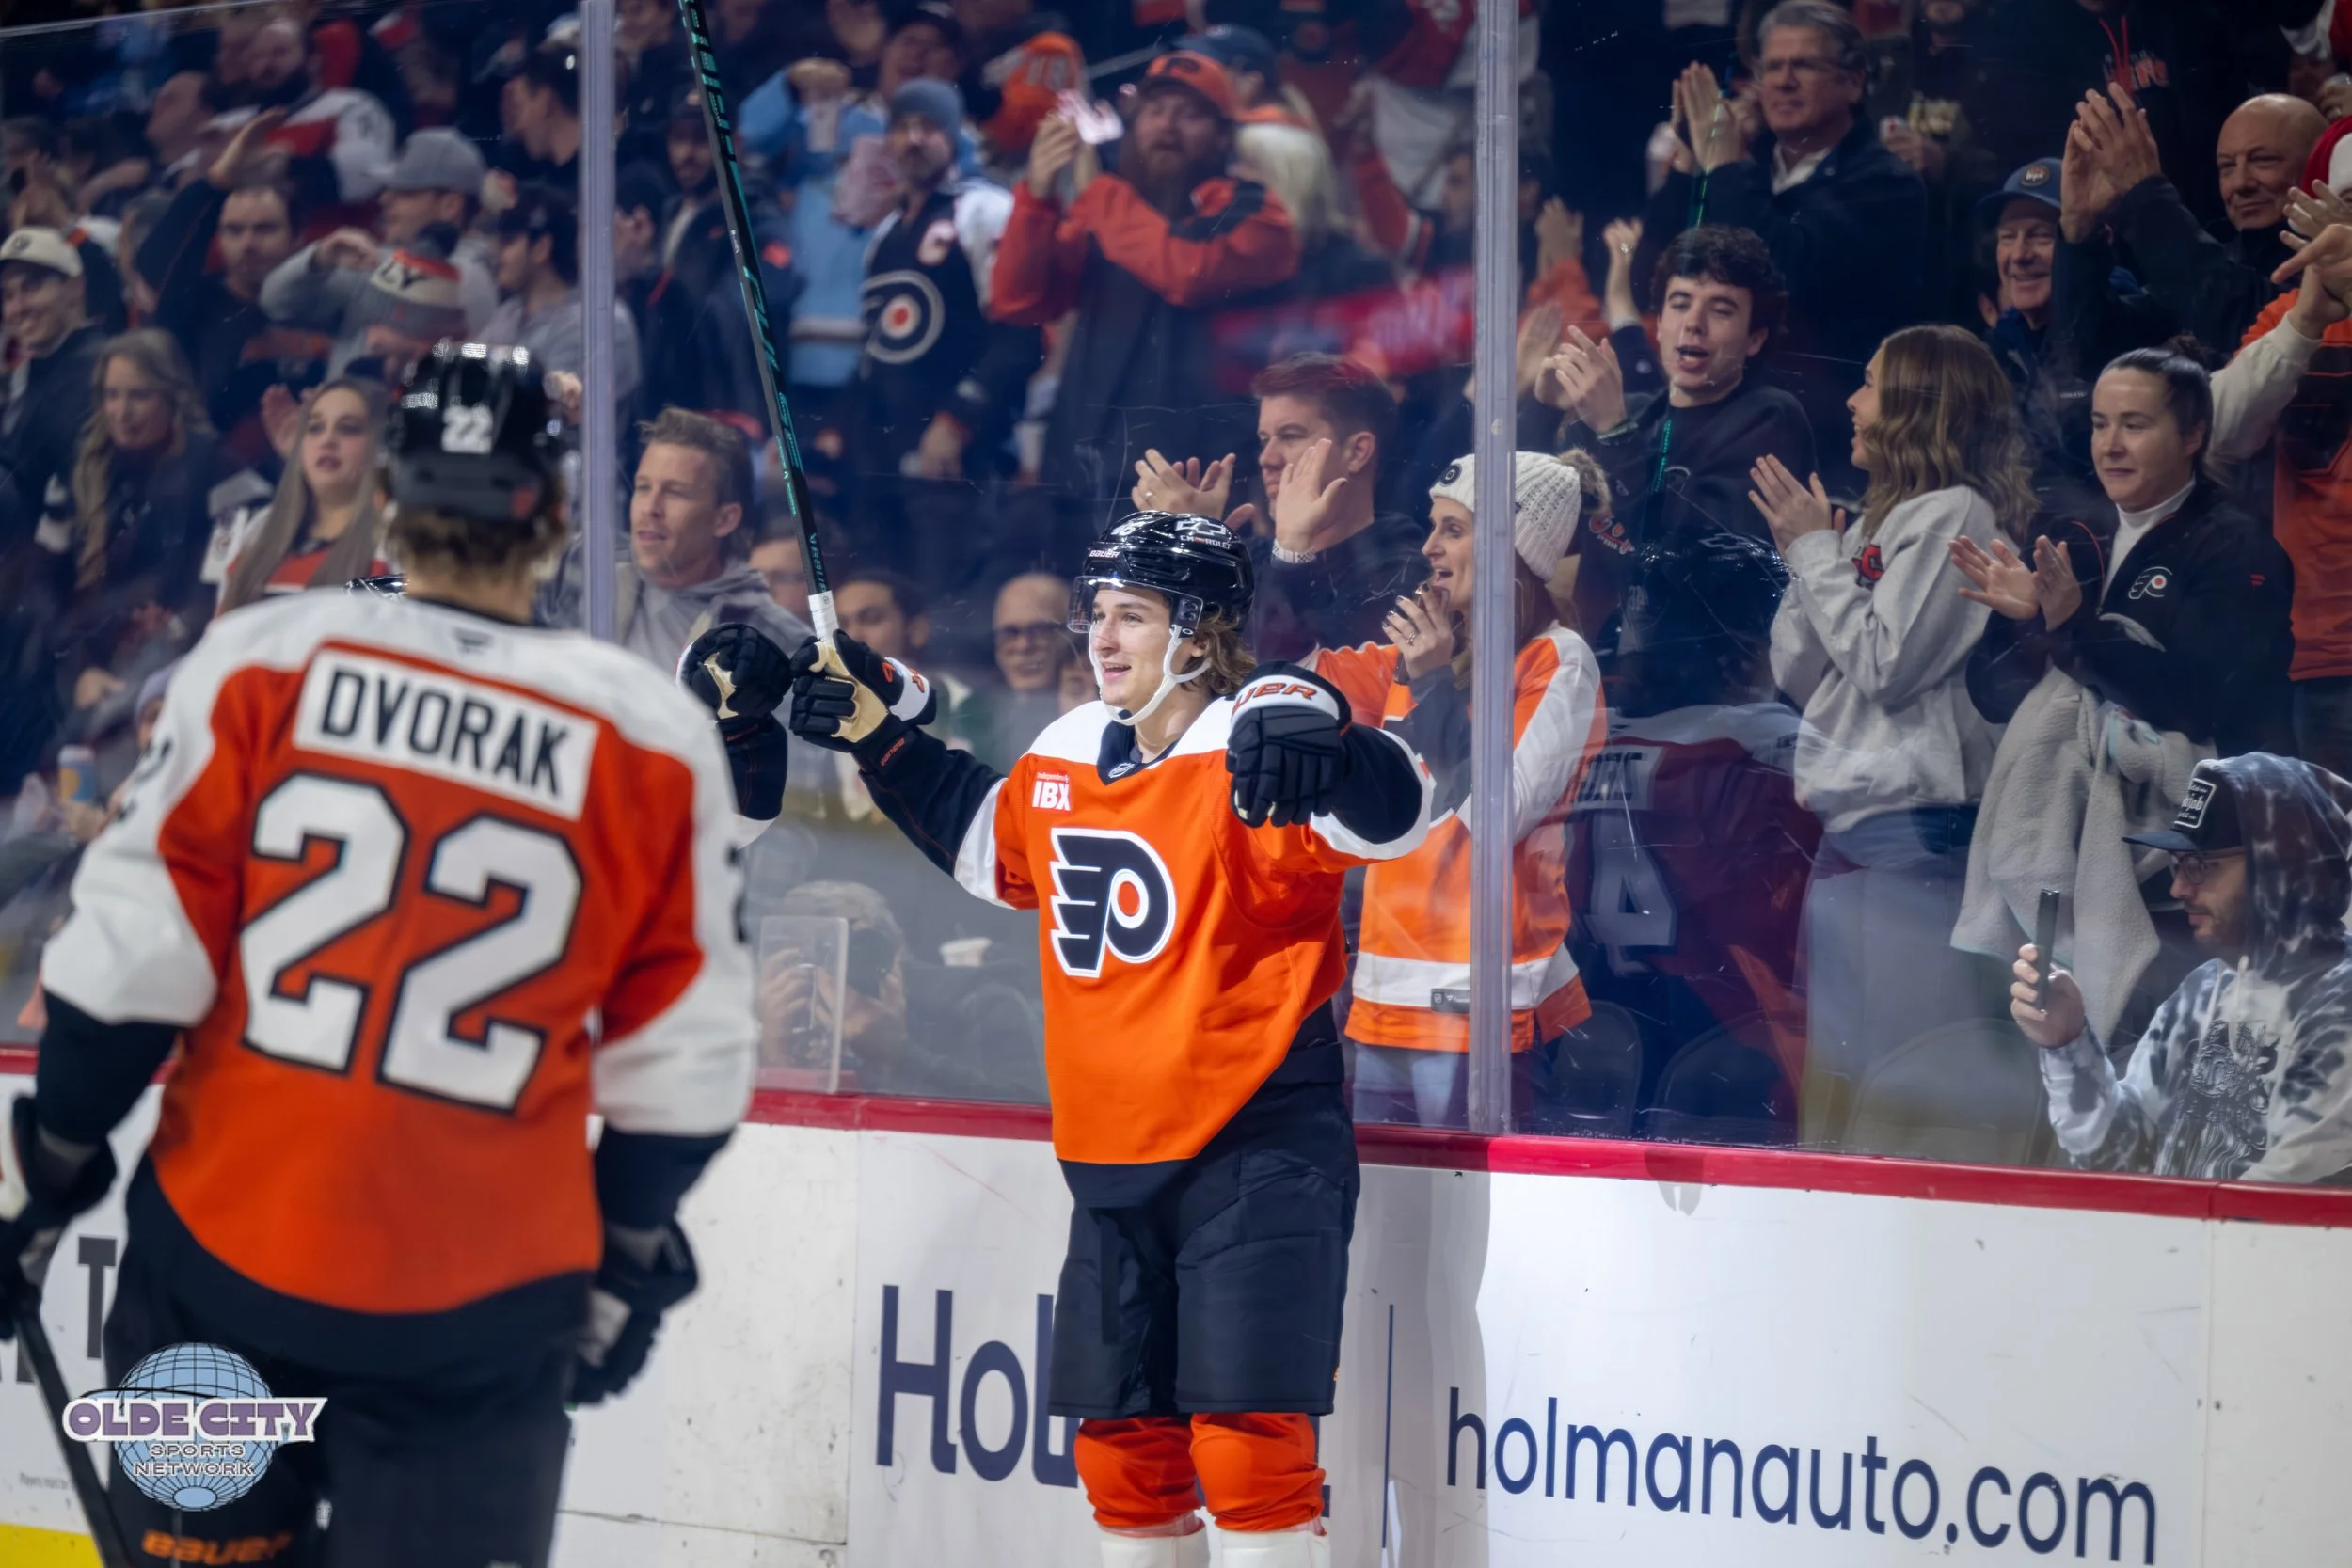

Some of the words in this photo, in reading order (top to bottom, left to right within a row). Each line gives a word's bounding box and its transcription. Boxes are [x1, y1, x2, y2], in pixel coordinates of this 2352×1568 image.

[441, 404, 494, 454] 22
[320, 665, 568, 798] DVORAK
[1032, 780, 1072, 811] IBX
[240, 766, 585, 1117] 22
[1447, 1386, 2157, 1565] holmanauto.com
